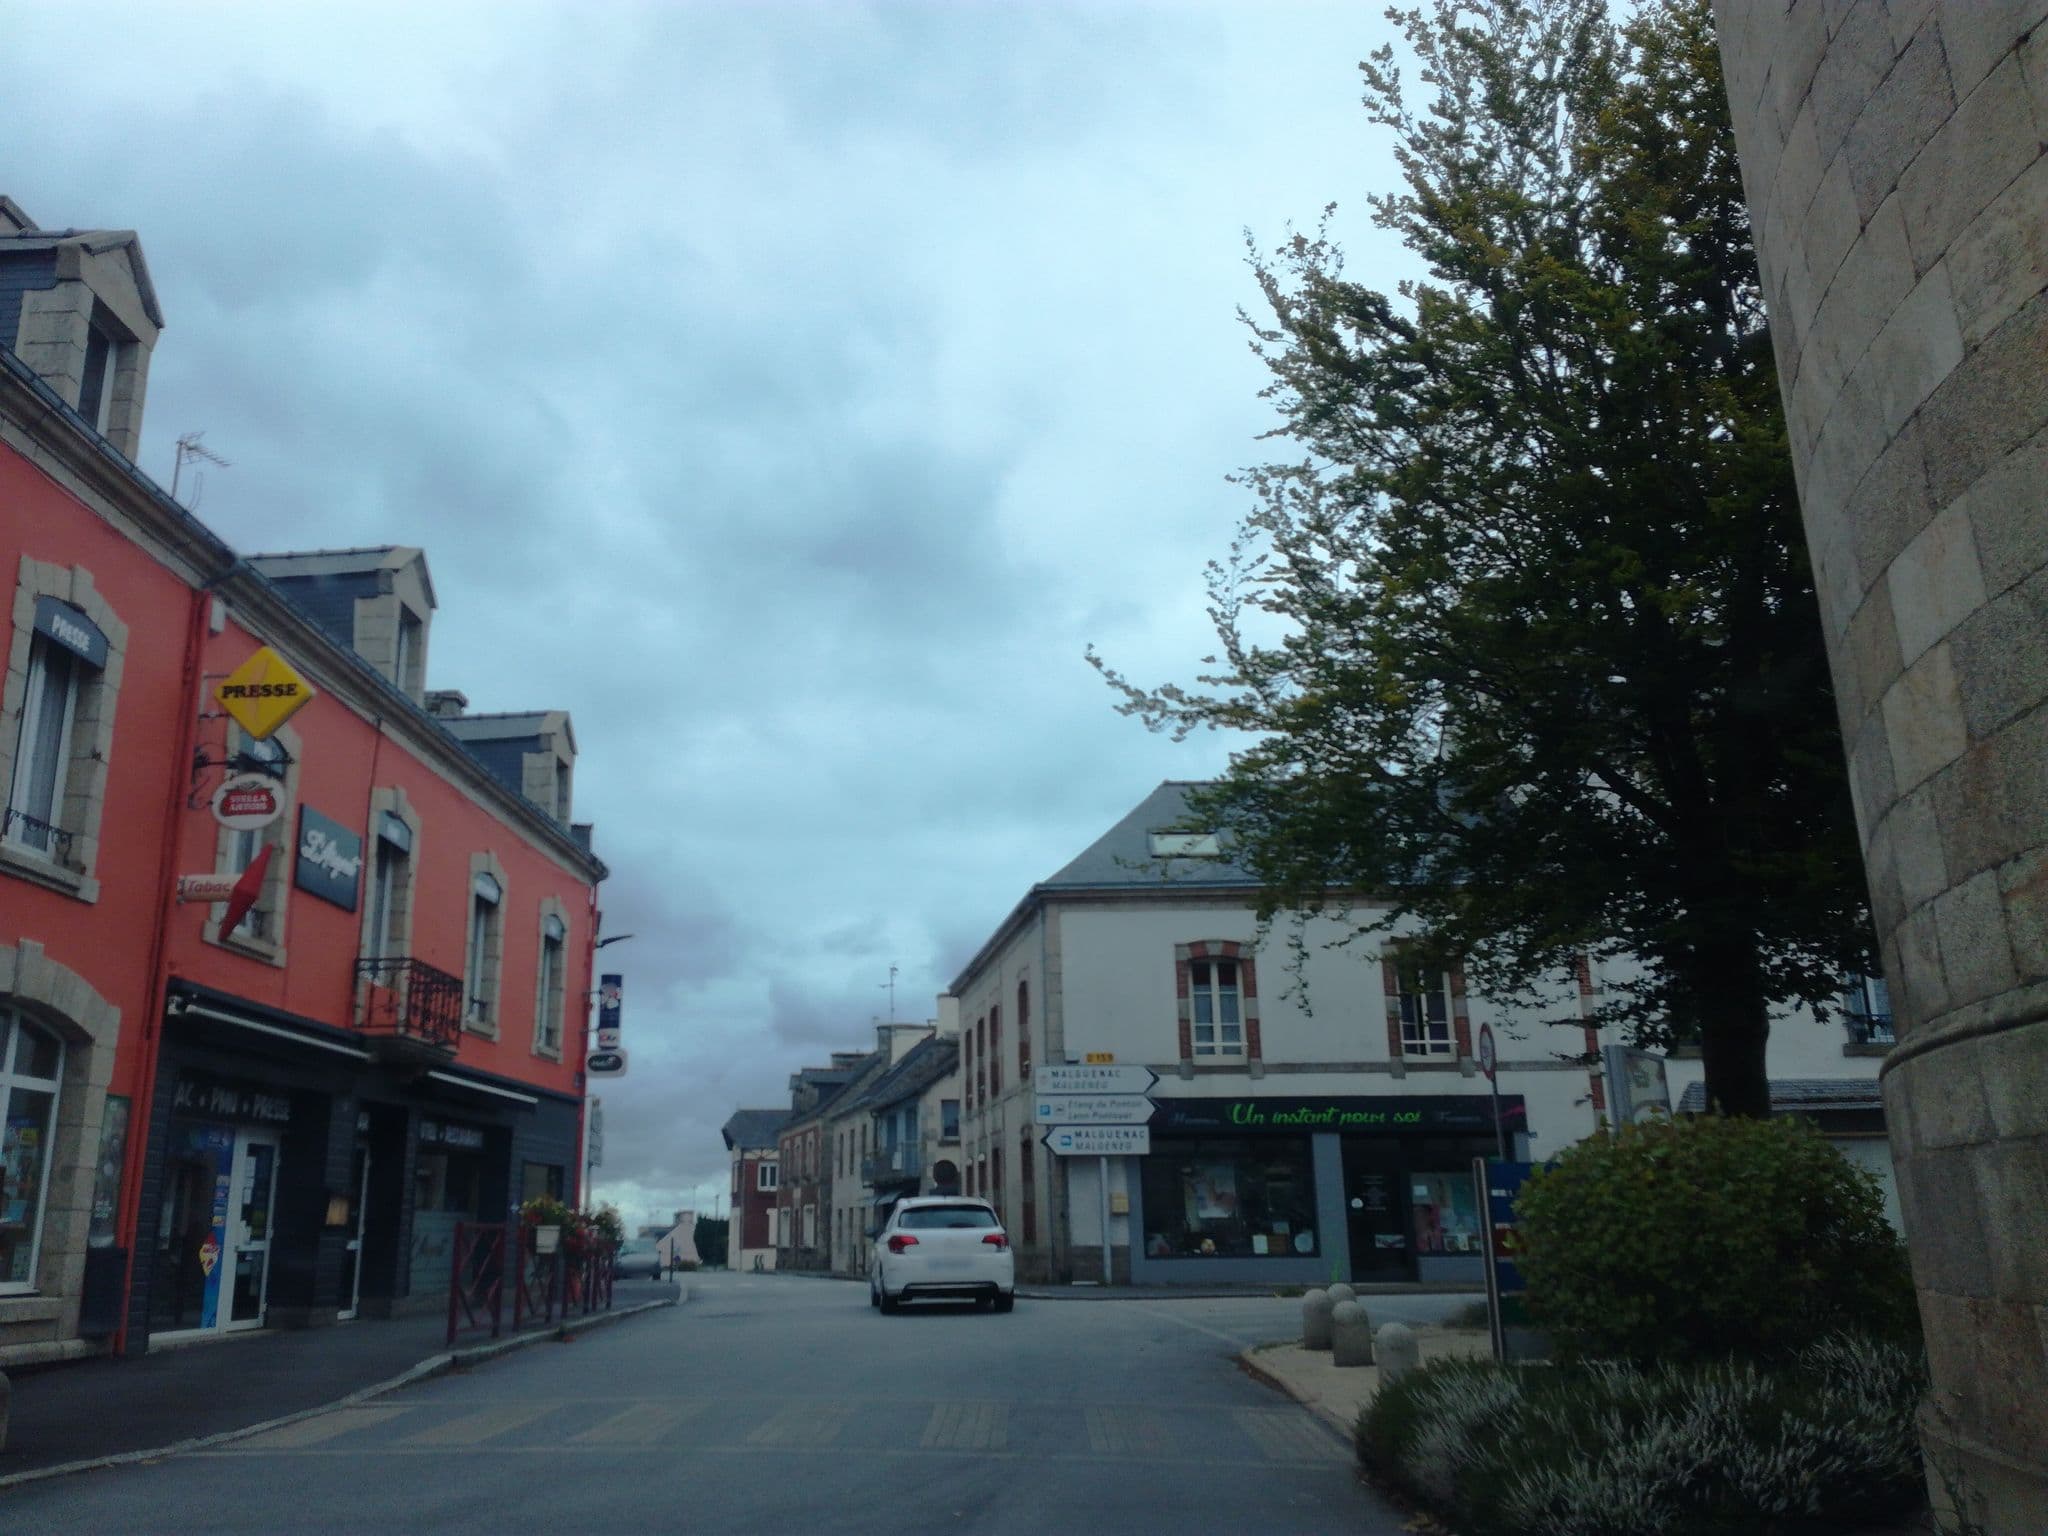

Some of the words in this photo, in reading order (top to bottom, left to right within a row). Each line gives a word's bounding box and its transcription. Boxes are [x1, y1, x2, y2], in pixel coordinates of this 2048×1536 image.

[221, 682, 298, 699] PRESSE
[187, 879, 231, 893] Tabac
[1232, 1103, 1264, 1124] Un
[1272, 1106, 1341, 1124] instant
[1339, 1110, 1386, 1126] pour
[1393, 1110, 1423, 1124] soi
[1075, 1130, 1145, 1139] MALGUENAC
